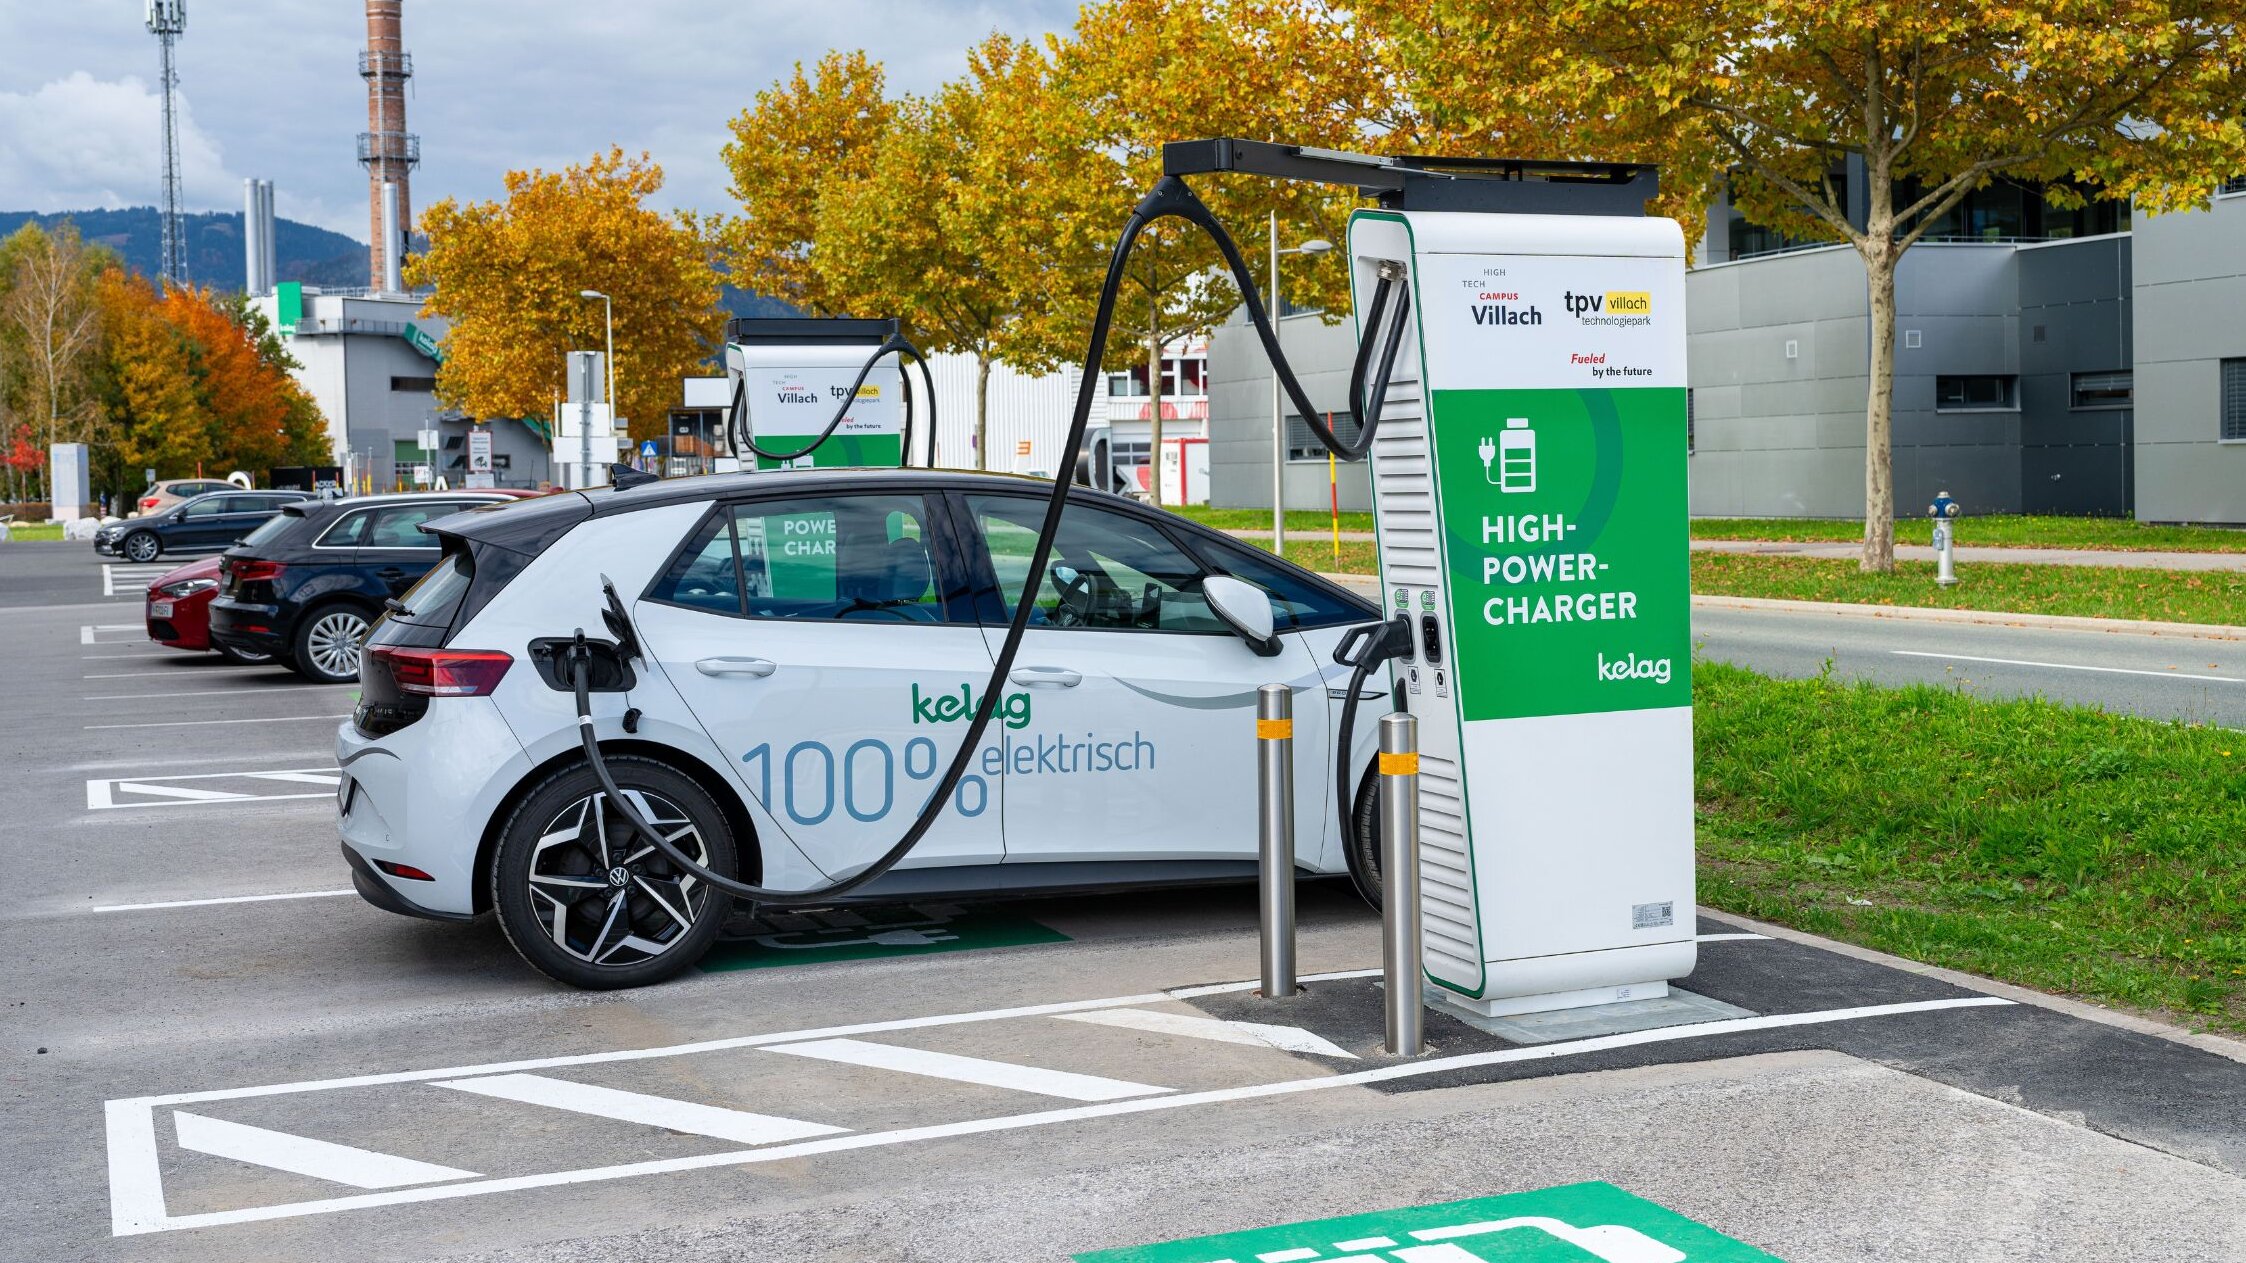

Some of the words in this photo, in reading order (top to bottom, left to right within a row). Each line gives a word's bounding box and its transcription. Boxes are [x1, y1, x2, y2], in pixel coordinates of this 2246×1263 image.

[1483, 268, 1506, 277] HIGH
[1462, 280, 1486, 288] TECH
[1479, 292, 1519, 301] CAMPUS
[1564, 291, 1603, 318] tpv
[1609, 296, 1647, 310] villach
[1471, 305, 1542, 325] Villach
[1581, 316, 1651, 328] technologiepark
[1570, 353, 1606, 364] Fueled
[1592, 367, 1604, 379] by
[1605, 367, 1621, 376] the
[1622, 367, 1653, 376] future
[777, 392, 818, 404] Villach
[1481, 513, 1577, 544] HIGH-
[1483, 553, 1609, 585] POWER-
[1483, 591, 1637, 626] CHARGER
[1597, 652, 1671, 685] kelag
[742, 736, 988, 826] 100%
[981, 730, 1155, 776] elektrisch
